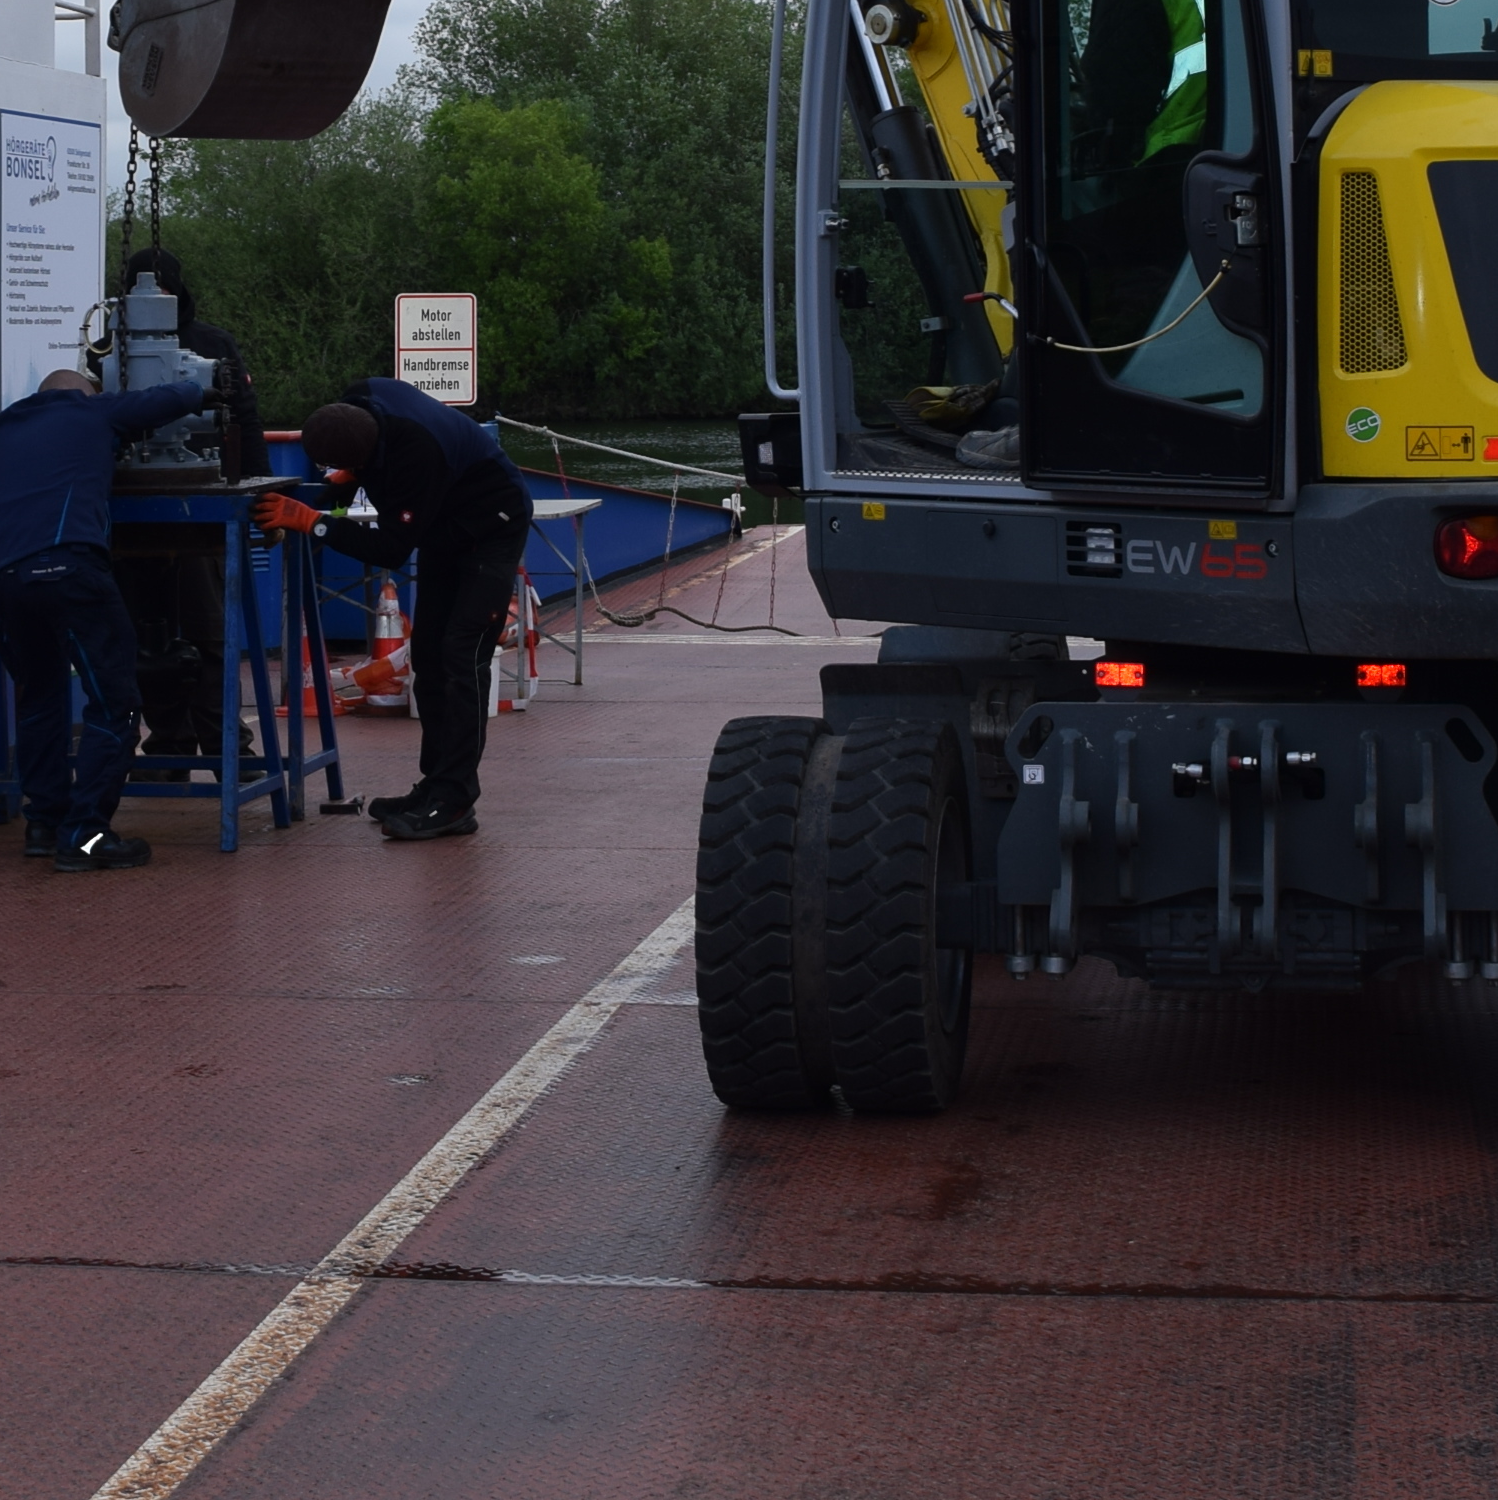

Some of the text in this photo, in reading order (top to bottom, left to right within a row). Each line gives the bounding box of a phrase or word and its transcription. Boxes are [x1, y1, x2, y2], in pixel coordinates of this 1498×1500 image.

[6, 136, 46, 156] HÖRGERÄTE
[6, 156, 46, 181] BONSEL
[421, 308, 453, 322] Motor
[412, 328, 461, 341] abstellen
[403, 358, 470, 372] Handbremse
[413, 377, 460, 390] anziehen
[1347, 414, 1381, 435] ECO
